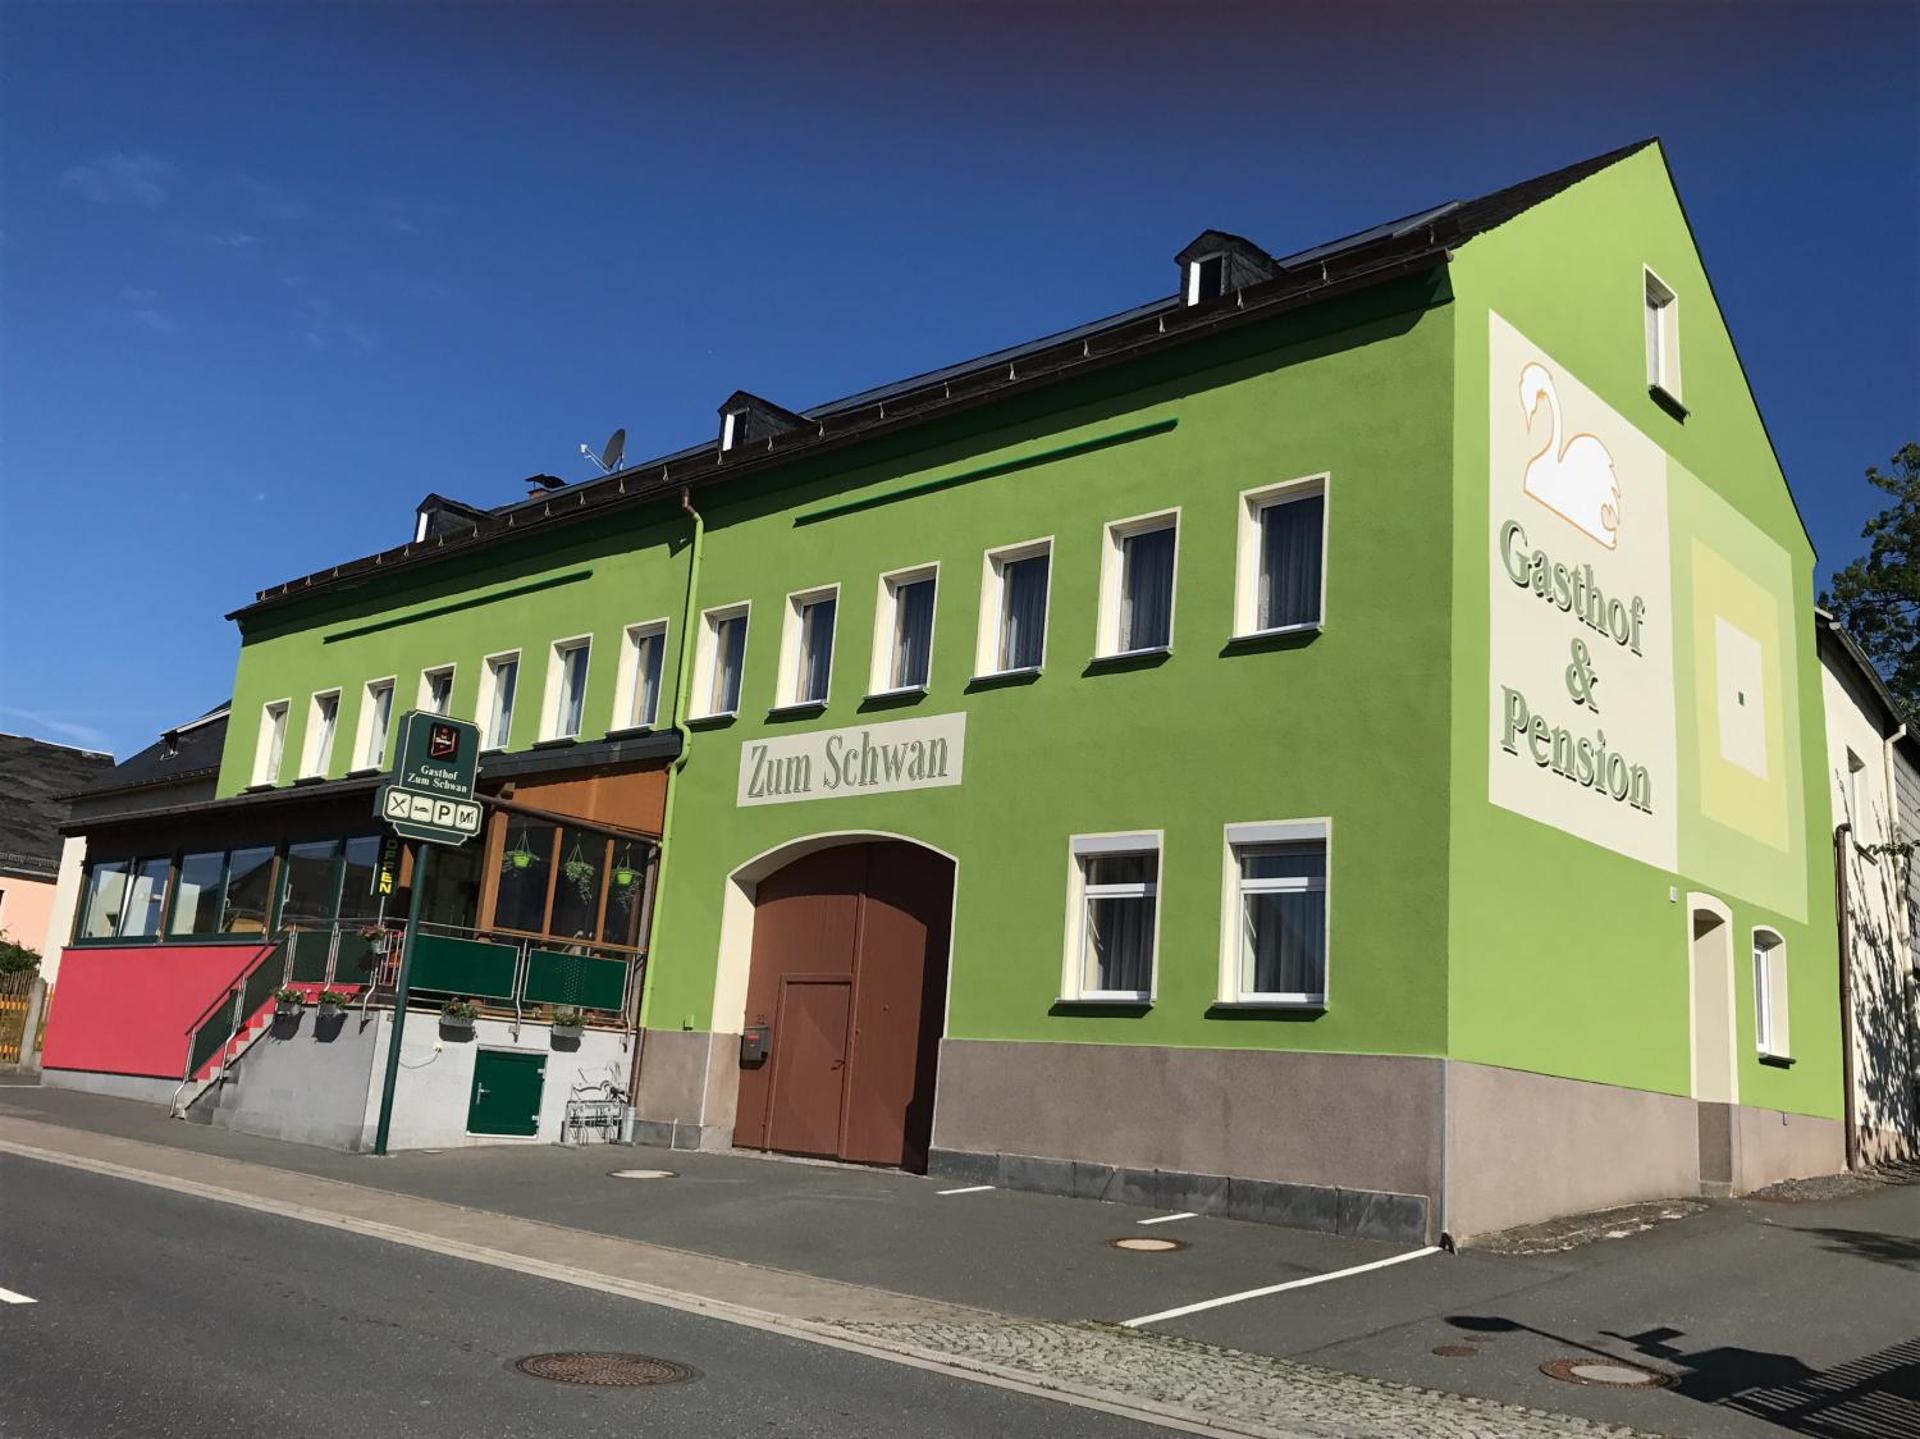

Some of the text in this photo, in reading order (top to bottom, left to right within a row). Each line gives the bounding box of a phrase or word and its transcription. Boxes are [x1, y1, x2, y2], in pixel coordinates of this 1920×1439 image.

[1500, 519, 1646, 657] Gasthof
[1565, 637, 1599, 714] &
[407, 772, 468, 793] Zum Schwan
[420, 765, 458, 781] Gasthof
[748, 731, 948, 798] Zum Schwan
[1500, 684, 1653, 815] Pension
[438, 804, 451, 820] P
